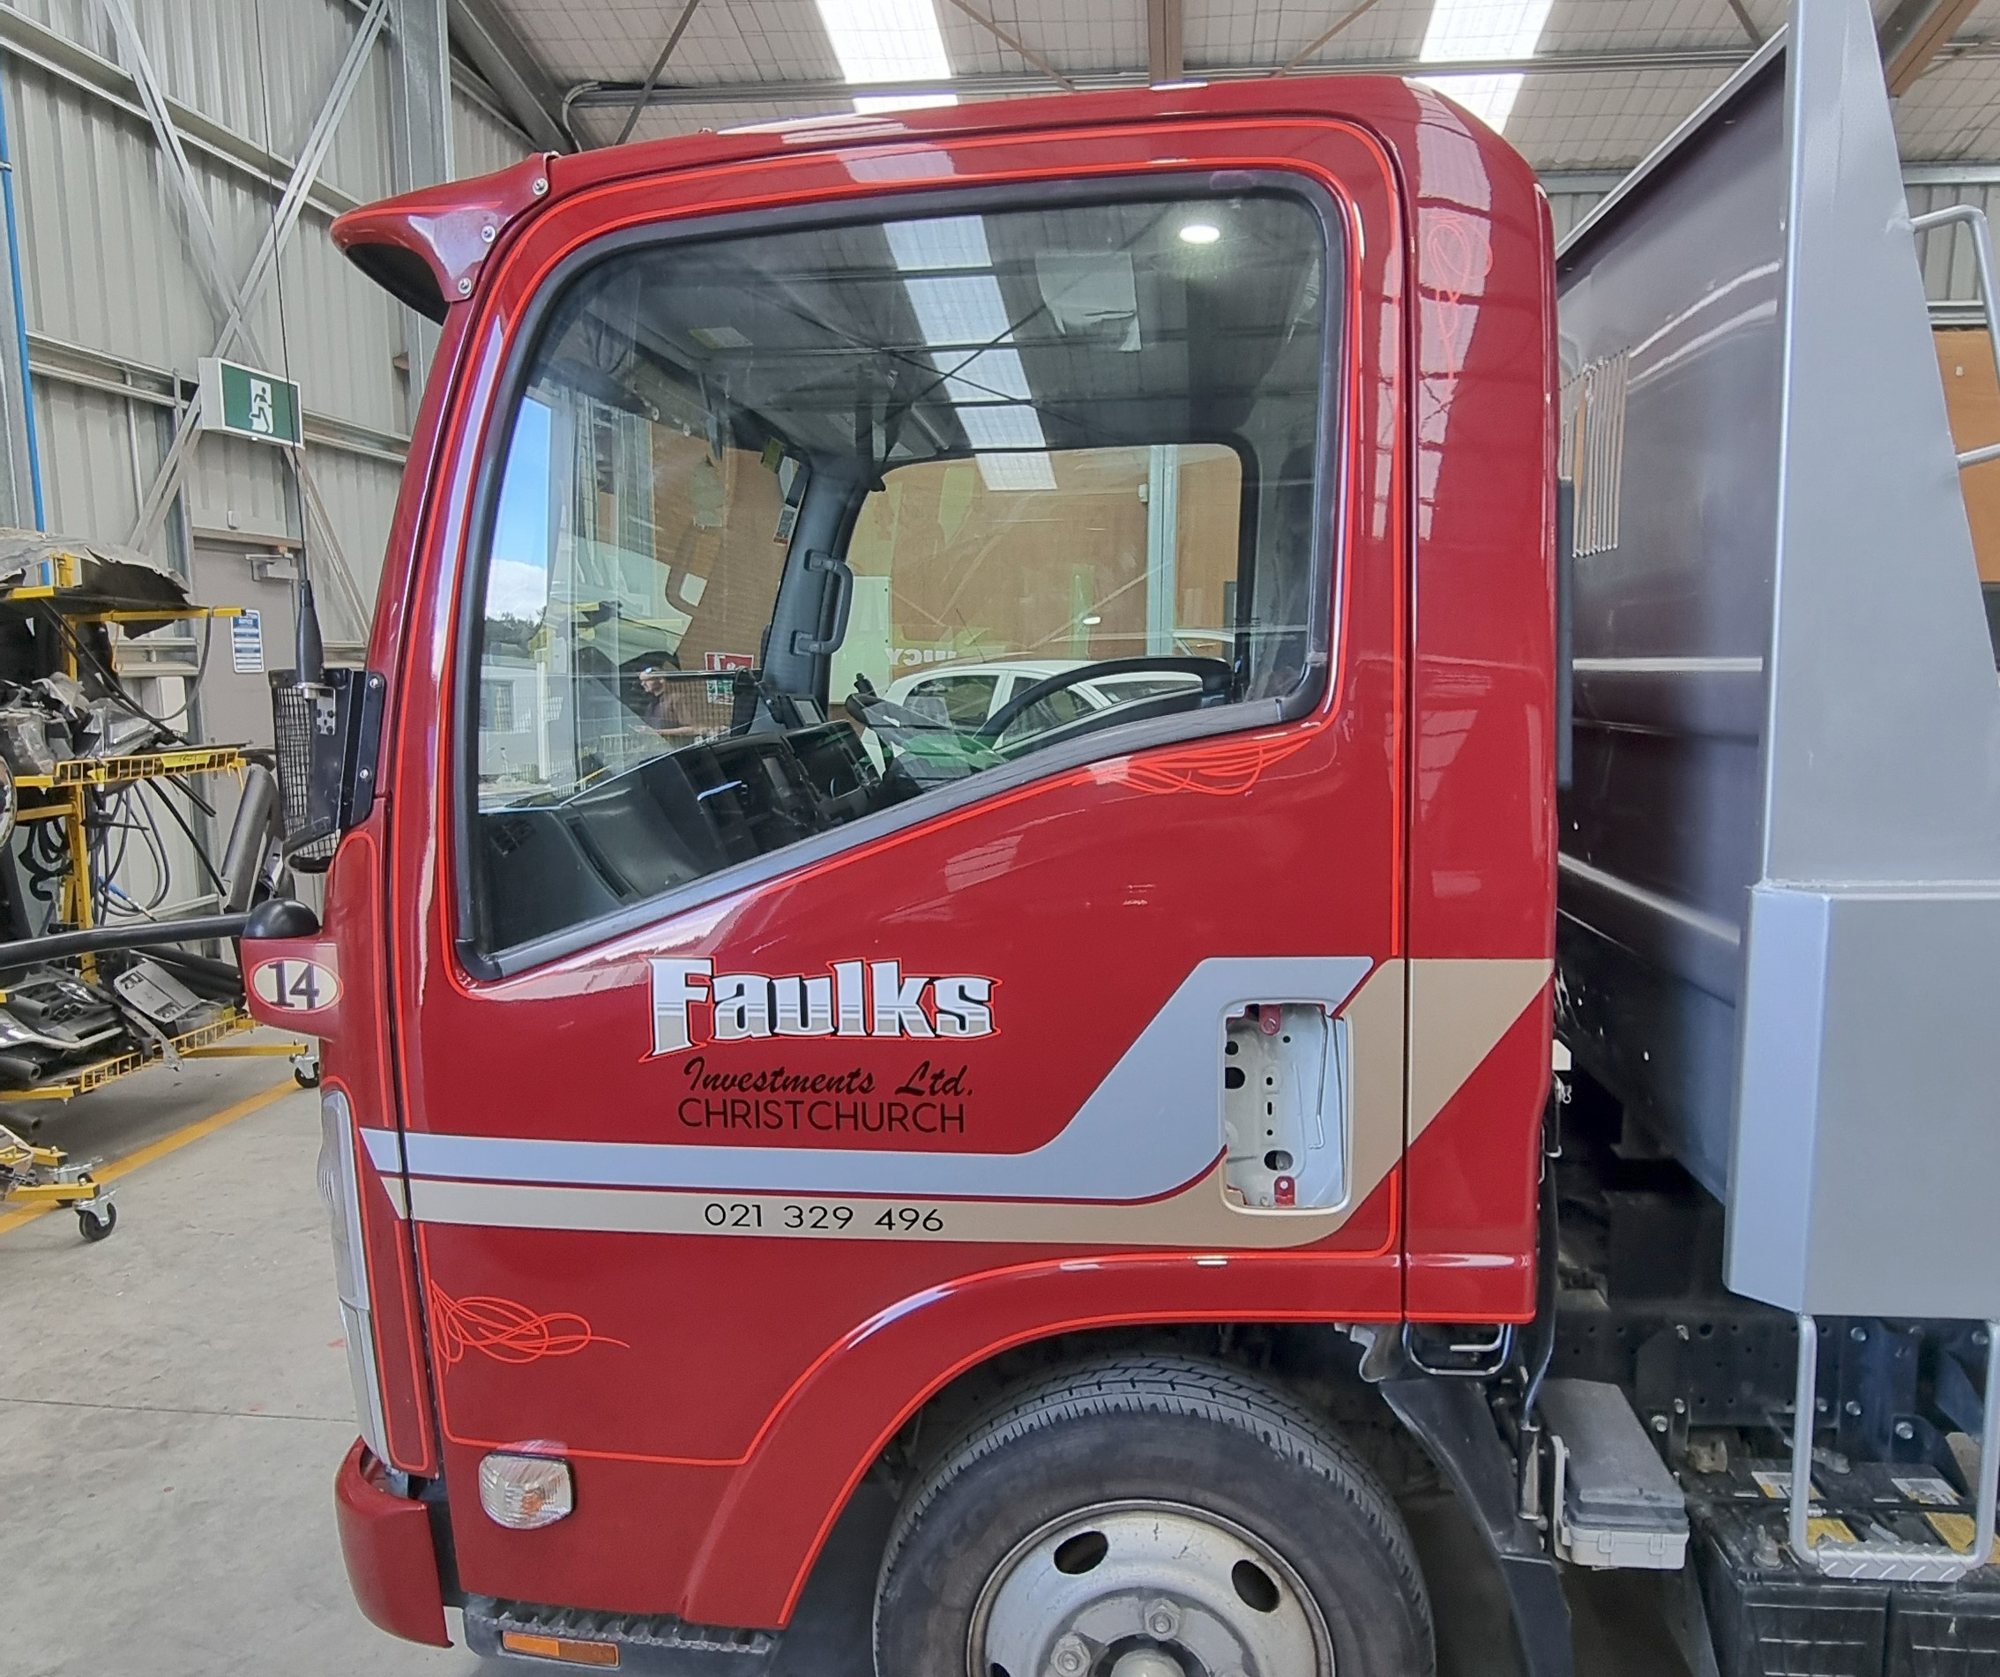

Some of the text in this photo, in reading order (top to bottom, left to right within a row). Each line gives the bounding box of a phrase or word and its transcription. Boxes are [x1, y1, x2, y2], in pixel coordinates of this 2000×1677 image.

[267, 959, 321, 1010] 14
[641, 956, 1002, 1061] Faulks
[683, 1056, 973, 1097] Investments Ltd.
[678, 1097, 965, 1134] CHRISTCHURCH
[704, 1203, 945, 1232] 021 329 496
